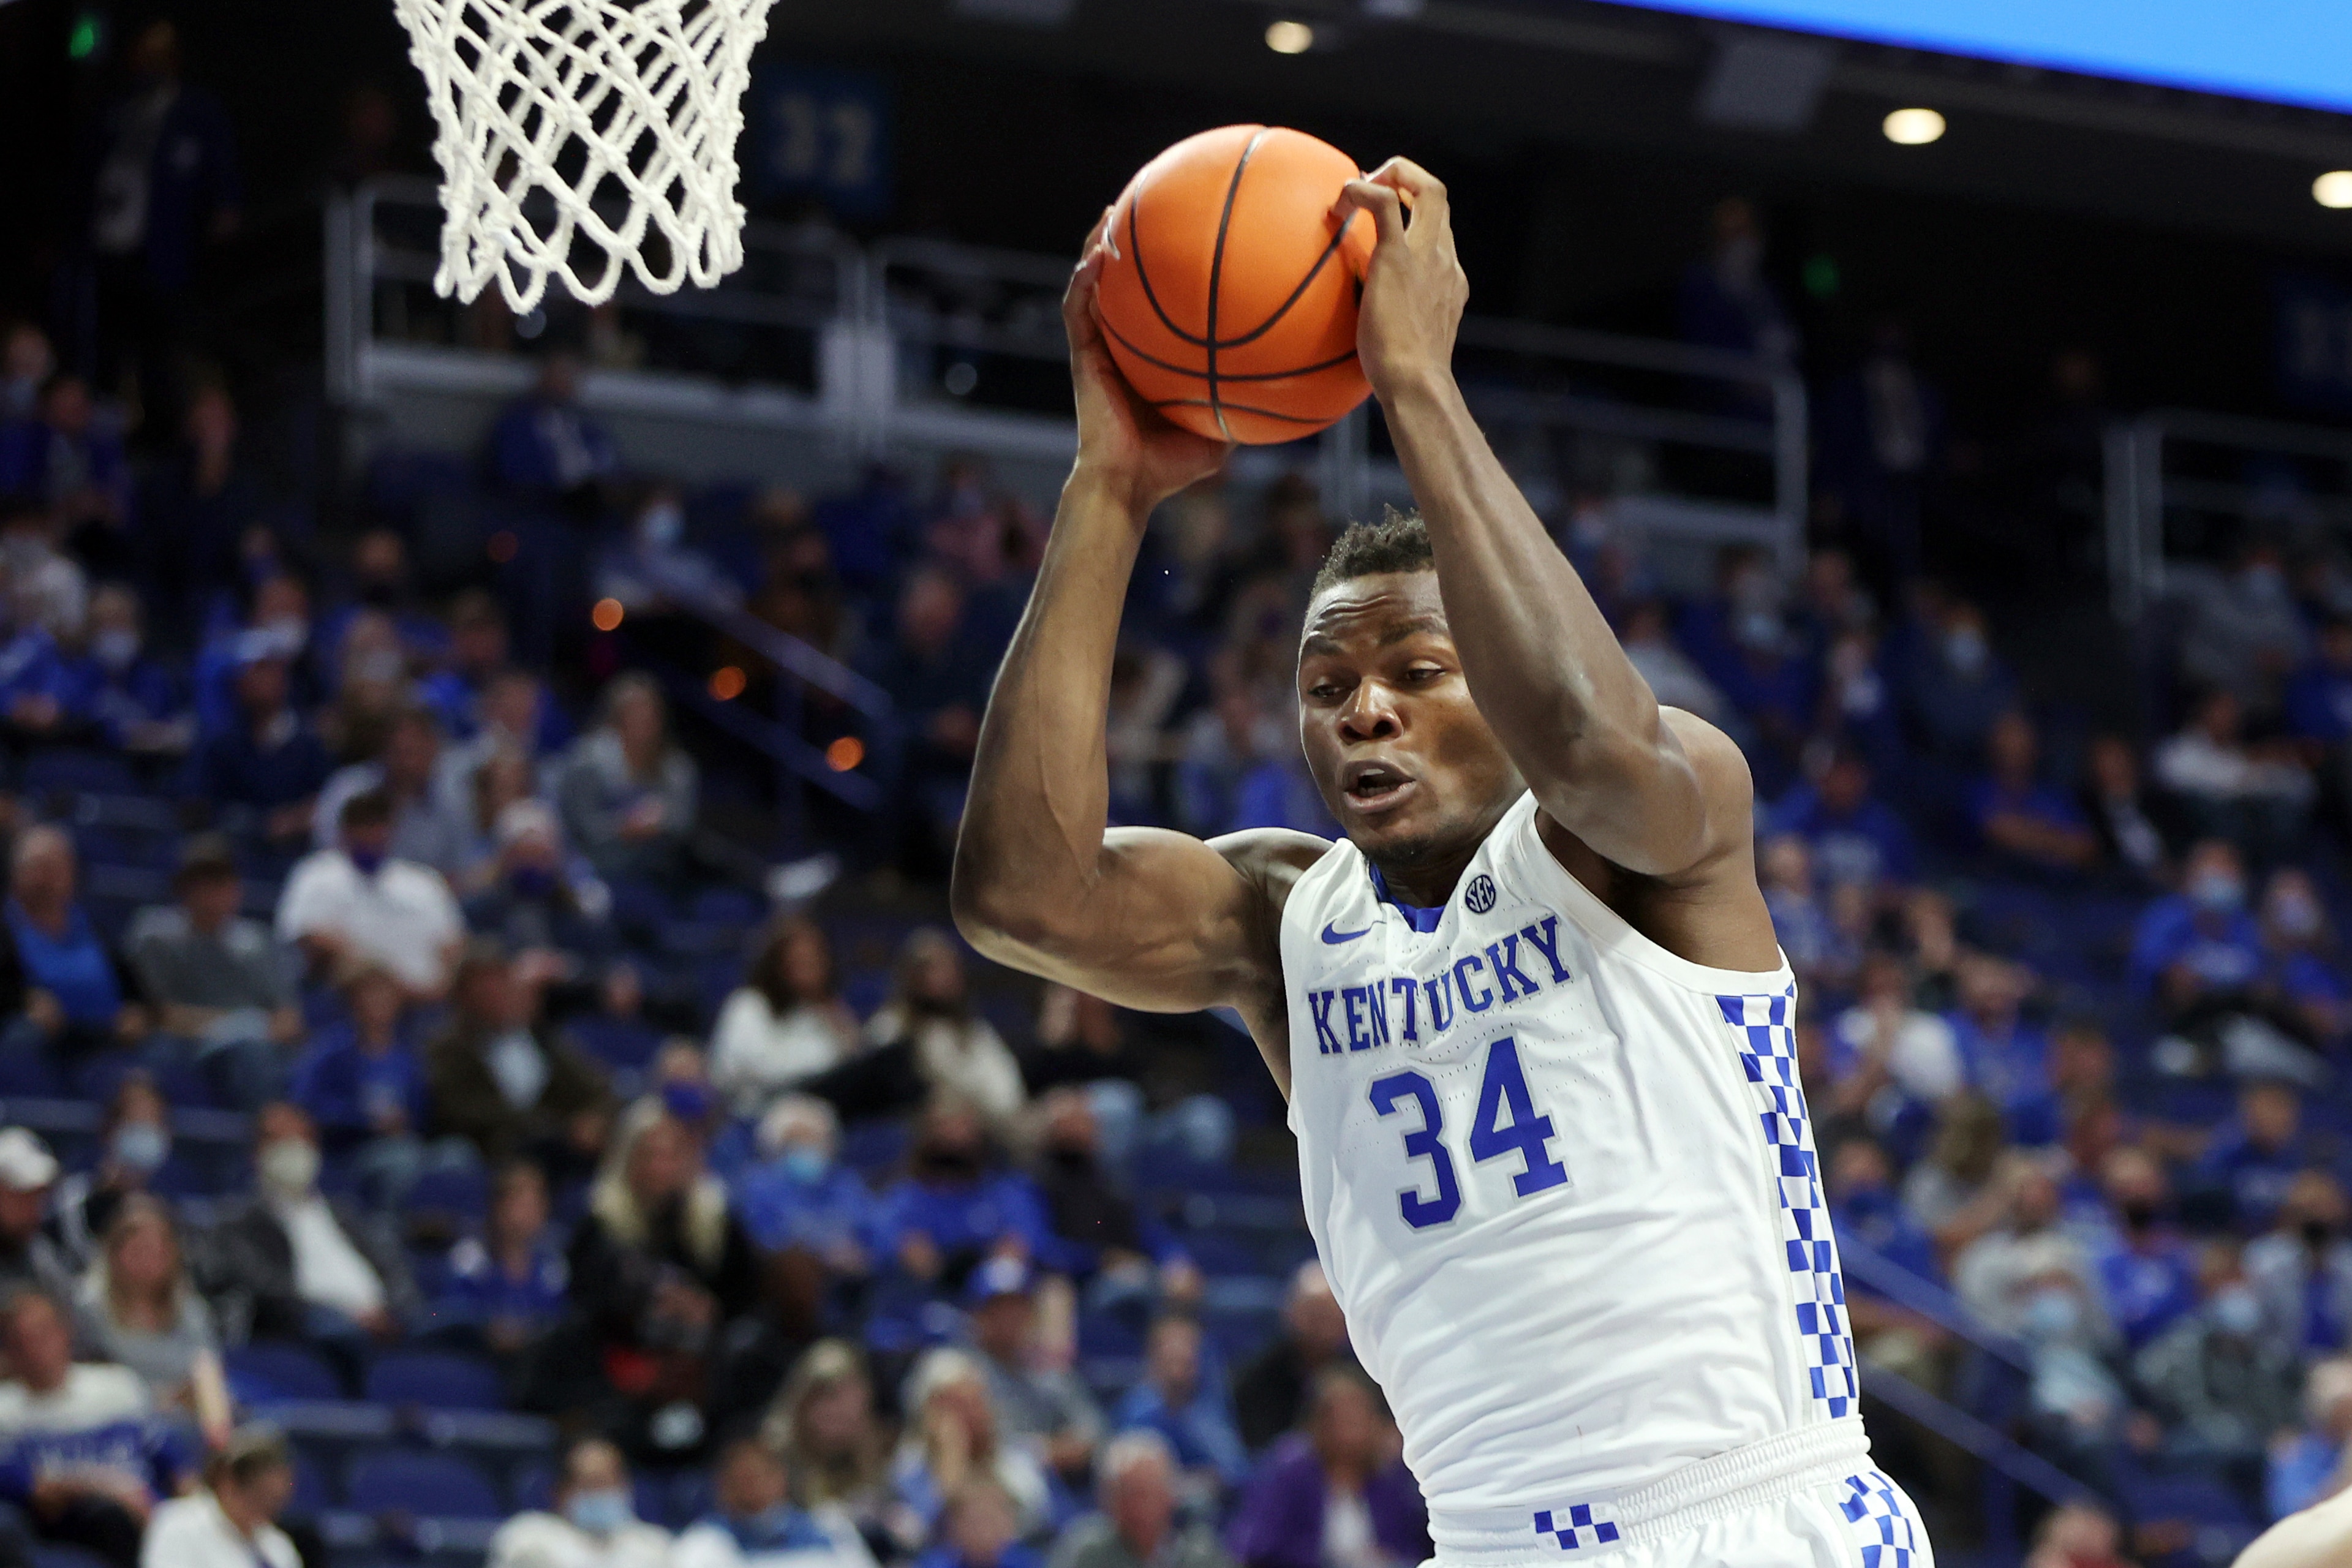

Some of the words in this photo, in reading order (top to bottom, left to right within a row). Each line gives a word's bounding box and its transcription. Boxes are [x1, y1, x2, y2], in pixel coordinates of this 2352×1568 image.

[1466, 876, 1495, 912] SEC
[1308, 915, 1571, 1055] KENTUCKY
[1368, 1035, 1569, 1229] 34
